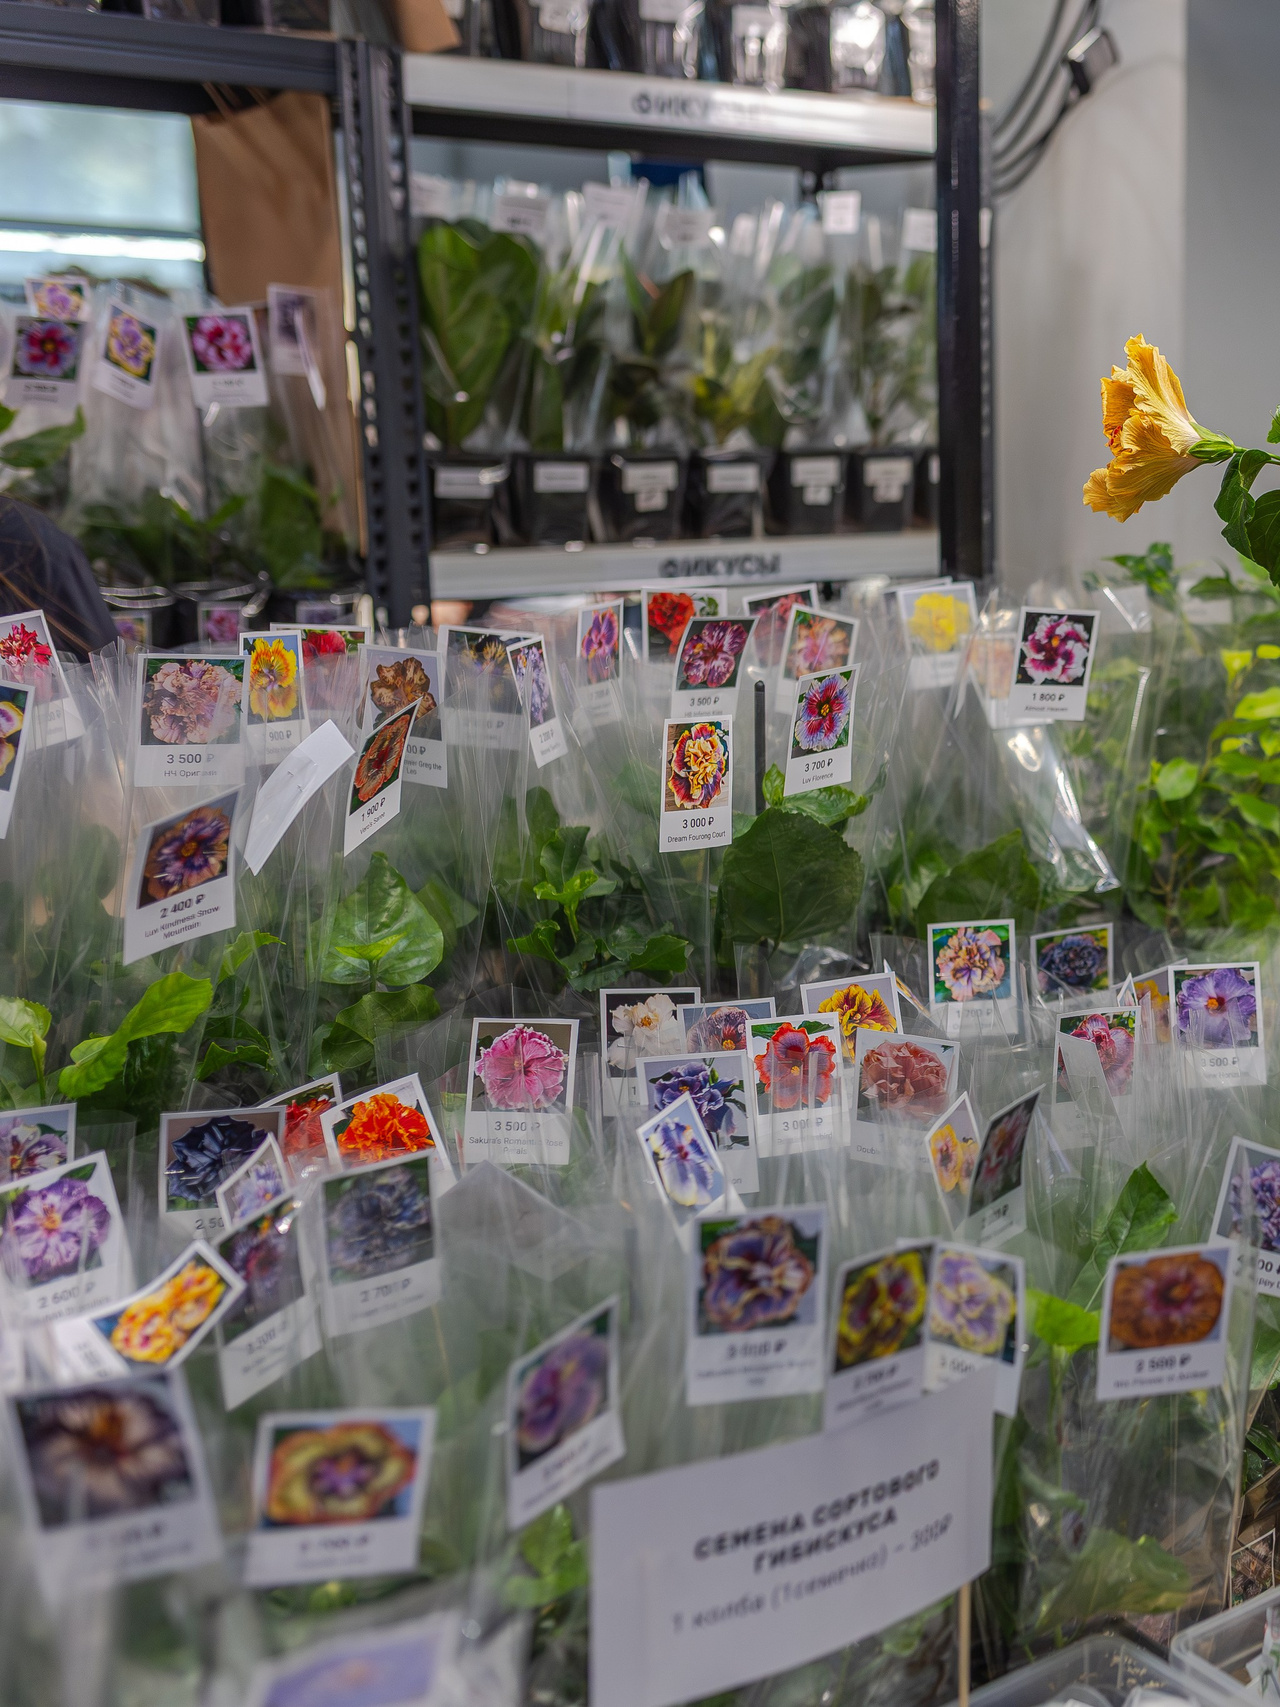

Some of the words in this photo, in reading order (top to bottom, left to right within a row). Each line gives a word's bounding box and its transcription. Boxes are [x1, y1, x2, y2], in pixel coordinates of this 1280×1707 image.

[659, 553, 782, 578] ФИКУСЫ
[166, 753, 175, 764] 3
[178, 753, 202, 764] 500
[804, 763, 810, 773] 3
[811, 759, 826, 771] 700
[802, 777, 812, 785] Luv
[812, 773, 834, 782] Florence
[682, 819, 689, 829] 3
[690, 817, 707, 828] 000
[712, 830, 726, 839] Court
[159, 907, 169, 919] 2
[170, 898, 194, 913] 400
[163, 921, 201, 940] Mountain
[494, 1121, 502, 1131] 3
[505, 1121, 527, 1131] 500
[783, 1121, 790, 1132] 3
[468, 1136, 502, 1145] Sakura's
[195, 1218, 205, 1230] 2
[694, 1512, 806, 1562] СЕМЕНА
[811, 1459, 940, 1528] СОРТОВОГО
[754, 1505, 897, 1574] ГИБИСКУСА
[693, 1590, 765, 1631] колба
